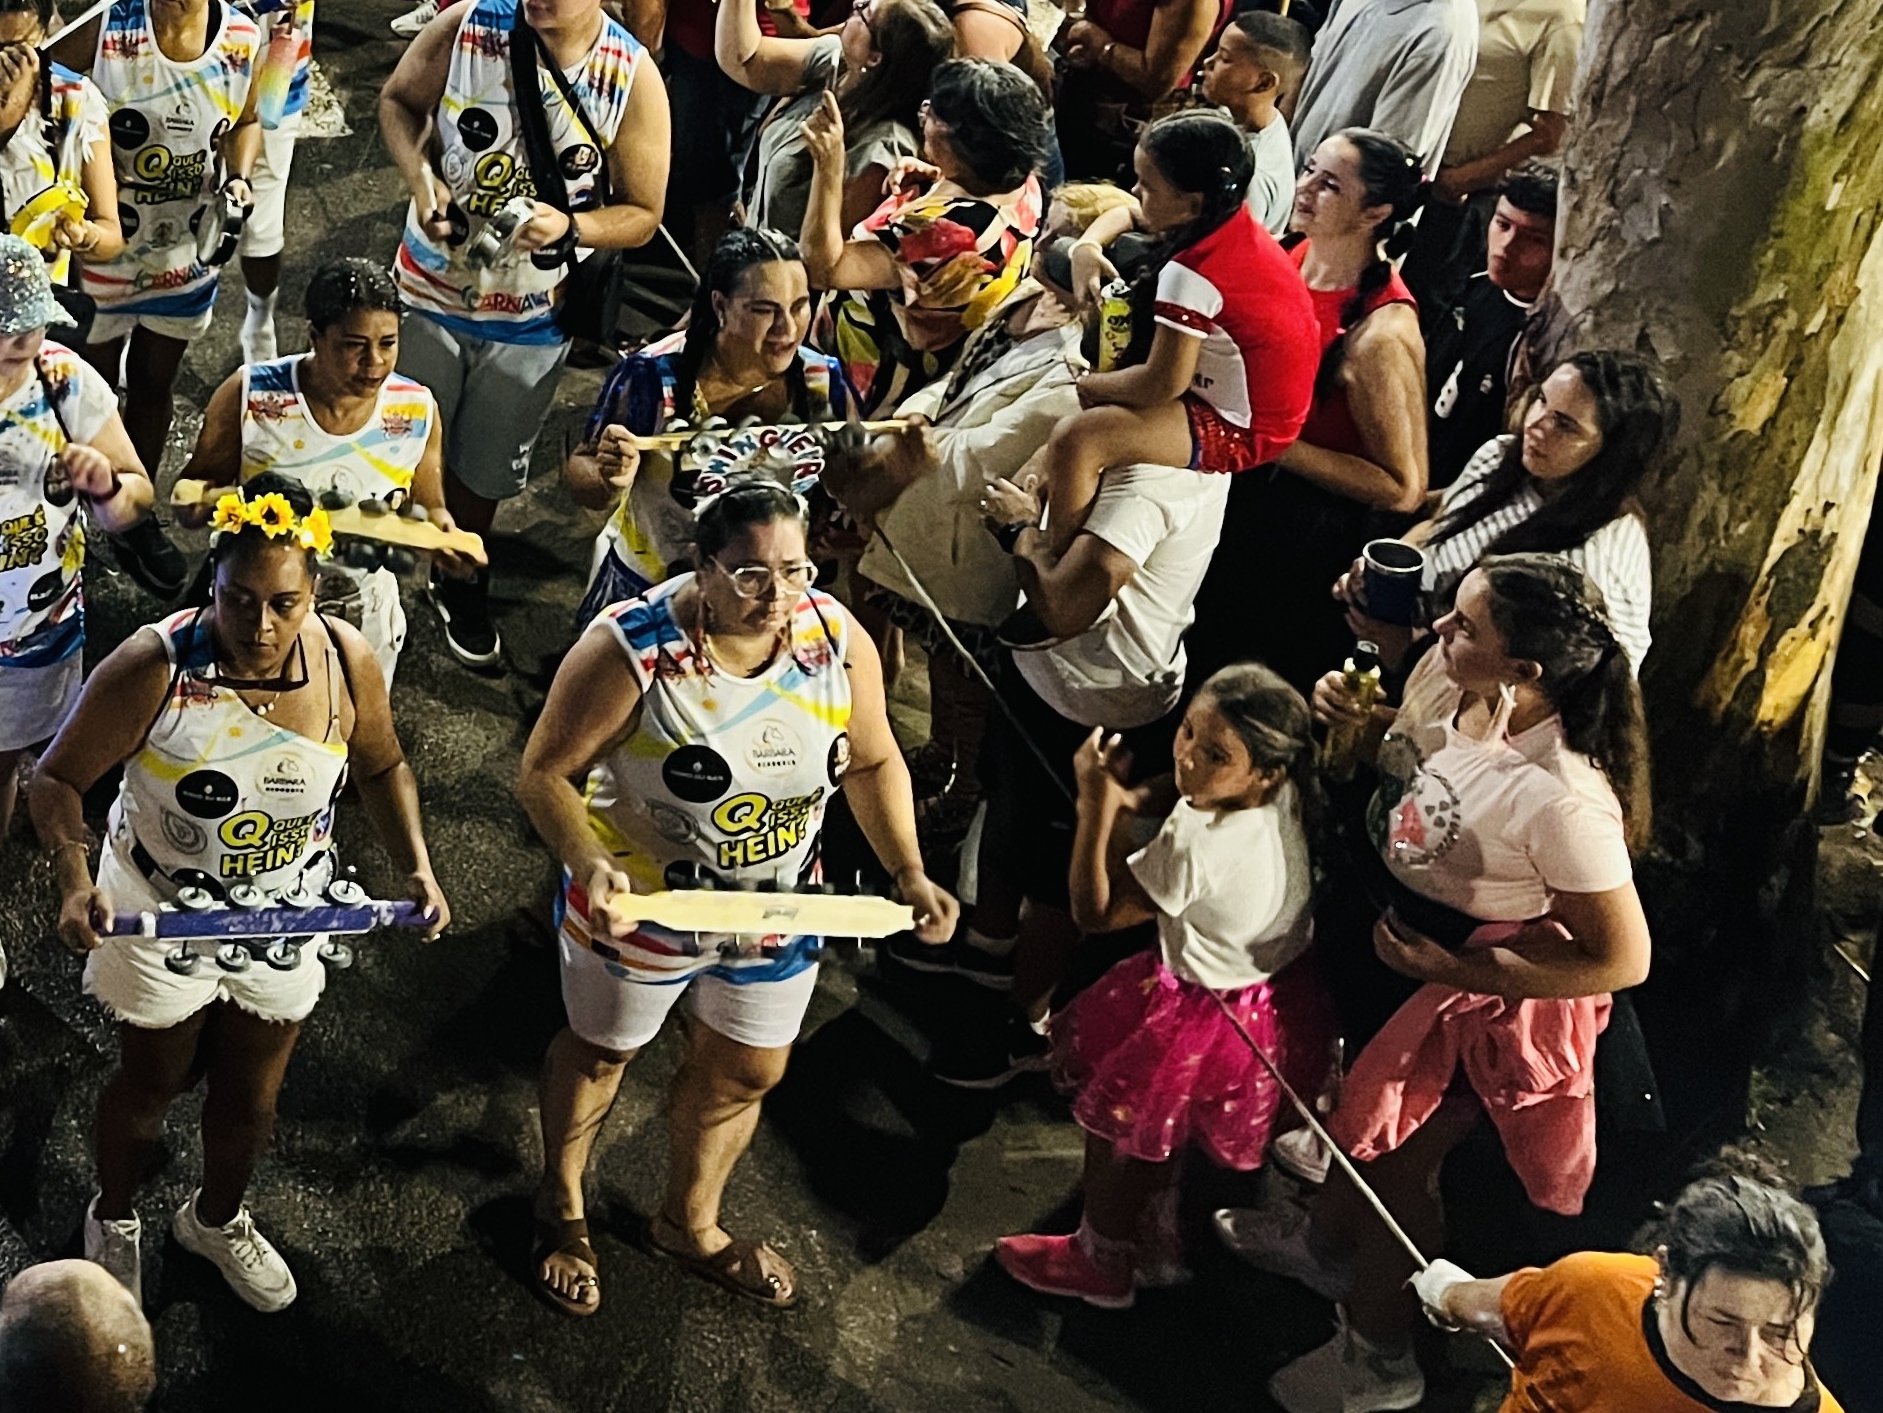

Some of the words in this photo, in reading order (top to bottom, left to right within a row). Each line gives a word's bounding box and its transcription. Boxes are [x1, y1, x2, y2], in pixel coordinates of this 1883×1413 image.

[134, 145, 172, 183] Q
[474, 151, 516, 191] Q
[218, 810, 274, 851] Q
[711, 791, 772, 837] Q
